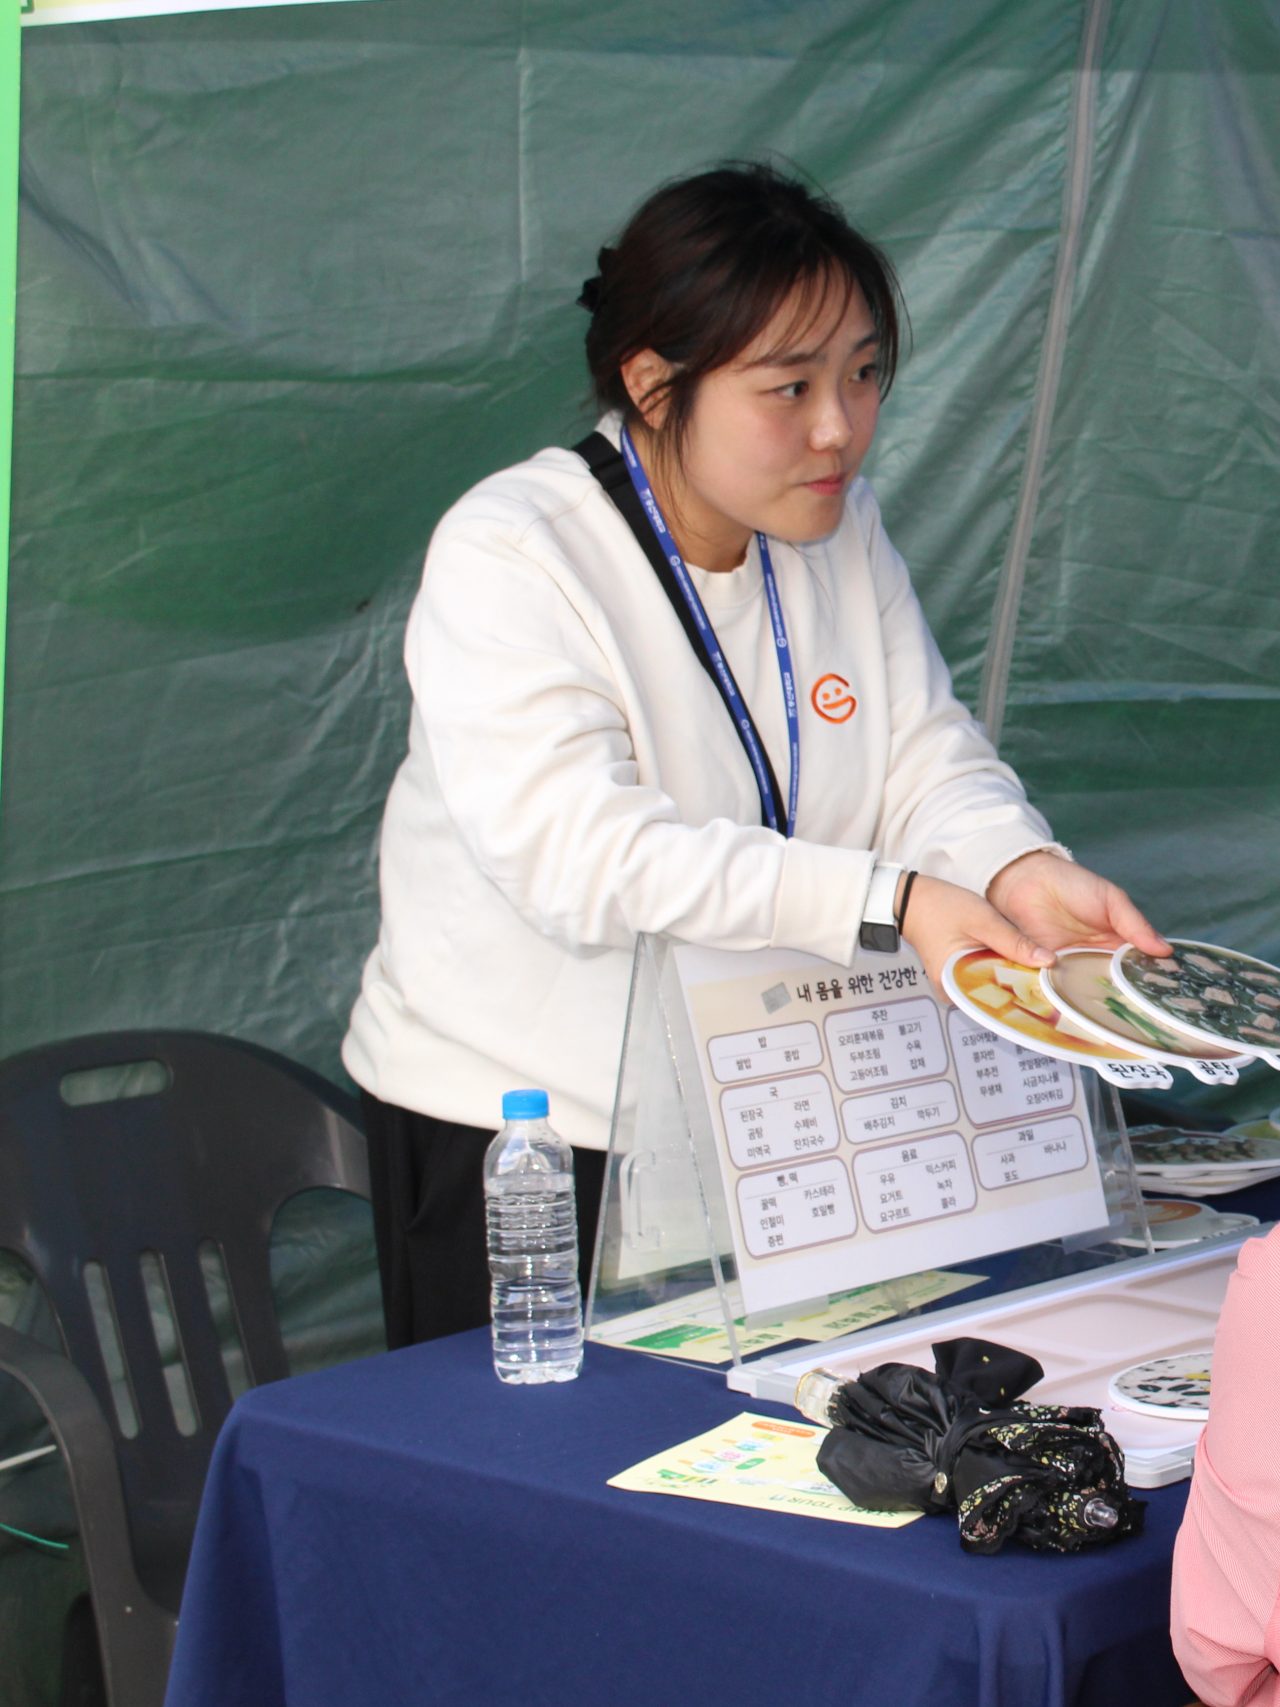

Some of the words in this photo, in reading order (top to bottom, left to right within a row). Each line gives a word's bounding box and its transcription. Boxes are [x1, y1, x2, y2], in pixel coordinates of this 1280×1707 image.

[797, 983, 812, 1003] 내
[816, 978, 843, 1001] 몸을
[848, 973, 874, 995] 위한
[878, 966, 918, 991] 건강한
[871, 1009, 888, 1022] 주찬
[898, 1021, 922, 1036] 불고기
[757, 1036, 768, 1048] 밥
[838, 1028, 885, 1046] 오리훈제볶음
[849, 1047, 882, 1063] 두부조림
[909, 1057, 926, 1070] 잡채
[1199, 1060, 1234, 1077] 곰탕
[849, 1065, 889, 1082] 고등어조림
[976, 1066, 999, 1080] 부추전
[1107, 1063, 1169, 1080] 된장국
[1023, 1071, 1060, 1087] 시금치나물
[769, 1086, 779, 1098] 국
[980, 1083, 1003, 1097] 무생채
[1026, 1089, 1064, 1105] 오징어튀김
[794, 1099, 811, 1112] 라면
[890, 1096, 907, 1109] 김치
[740, 1107, 764, 1122] 된장국
[917, 1106, 940, 1120] 깍두기
[794, 1115, 818, 1131] 수제비
[863, 1116, 896, 1131] 배추김치
[747, 1126, 764, 1140] 곰탕
[1018, 1129, 1034, 1141] 과일
[793, 1134, 825, 1151] 잔치국수
[1043, 1141, 1067, 1154] 바나나
[747, 1144, 771, 1158] 미역국
[901, 1148, 918, 1162] 음료
[1001, 1152, 1016, 1165] 사과
[925, 1160, 957, 1175] 믹스커피
[788, 1171, 799, 1183] 떡
[880, 1172, 895, 1185] 우유
[1004, 1170, 1019, 1182] 포도
[937, 1179, 953, 1190] 녹차
[804, 1184, 836, 1200] 카스테라
[880, 1190, 904, 1205] 요거트
[941, 1197, 957, 1209] 콜라
[880, 1207, 911, 1222] 요구르트
[760, 1215, 784, 1230] 인절미
[767, 1233, 784, 1248] 증편
[787, 1497, 834, 1509] TOUR
